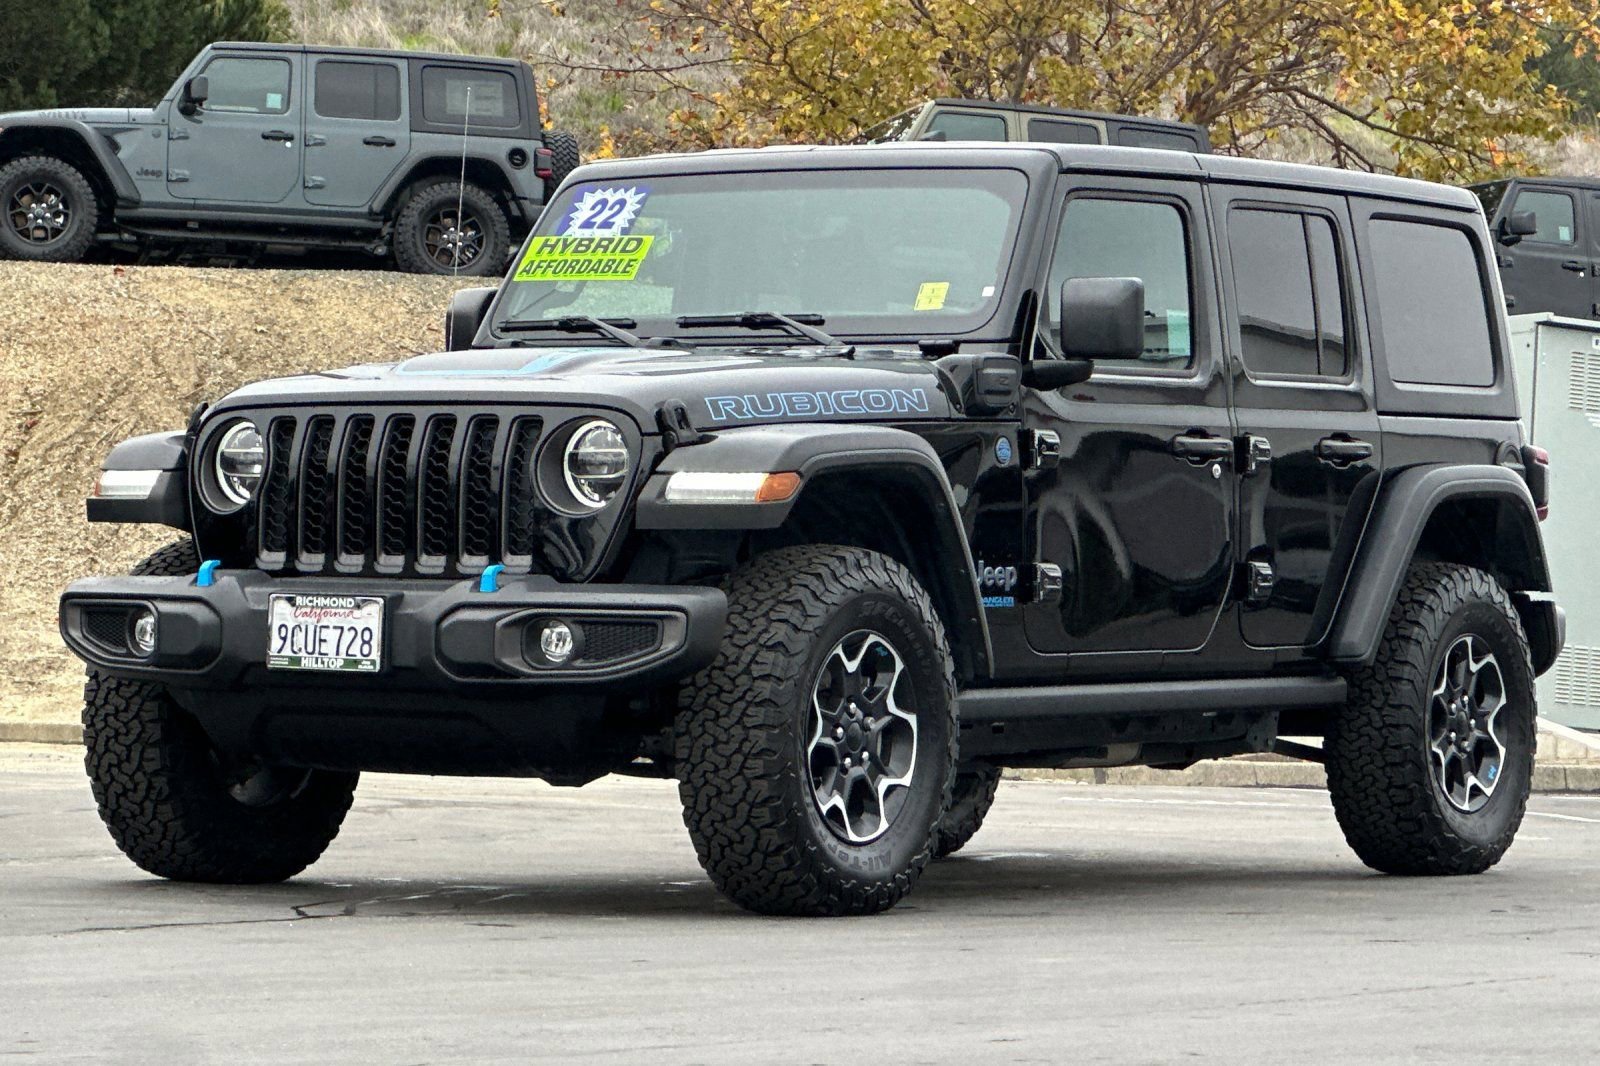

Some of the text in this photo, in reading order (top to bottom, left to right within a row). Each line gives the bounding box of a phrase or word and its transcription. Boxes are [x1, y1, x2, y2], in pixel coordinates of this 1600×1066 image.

[136, 166, 163, 178] Jeep
[578, 198, 627, 229] 22
[536, 237, 644, 255] HYBRID
[520, 259, 637, 275] AFFORDABLE
[704, 388, 929, 421] RUBICON
[976, 559, 1018, 592] Jeep
[296, 597, 354, 607] RICHMOND
[294, 607, 361, 623] California
[277, 624, 373, 657] 9CUE728
[301, 657, 344, 668] HILLTOP
